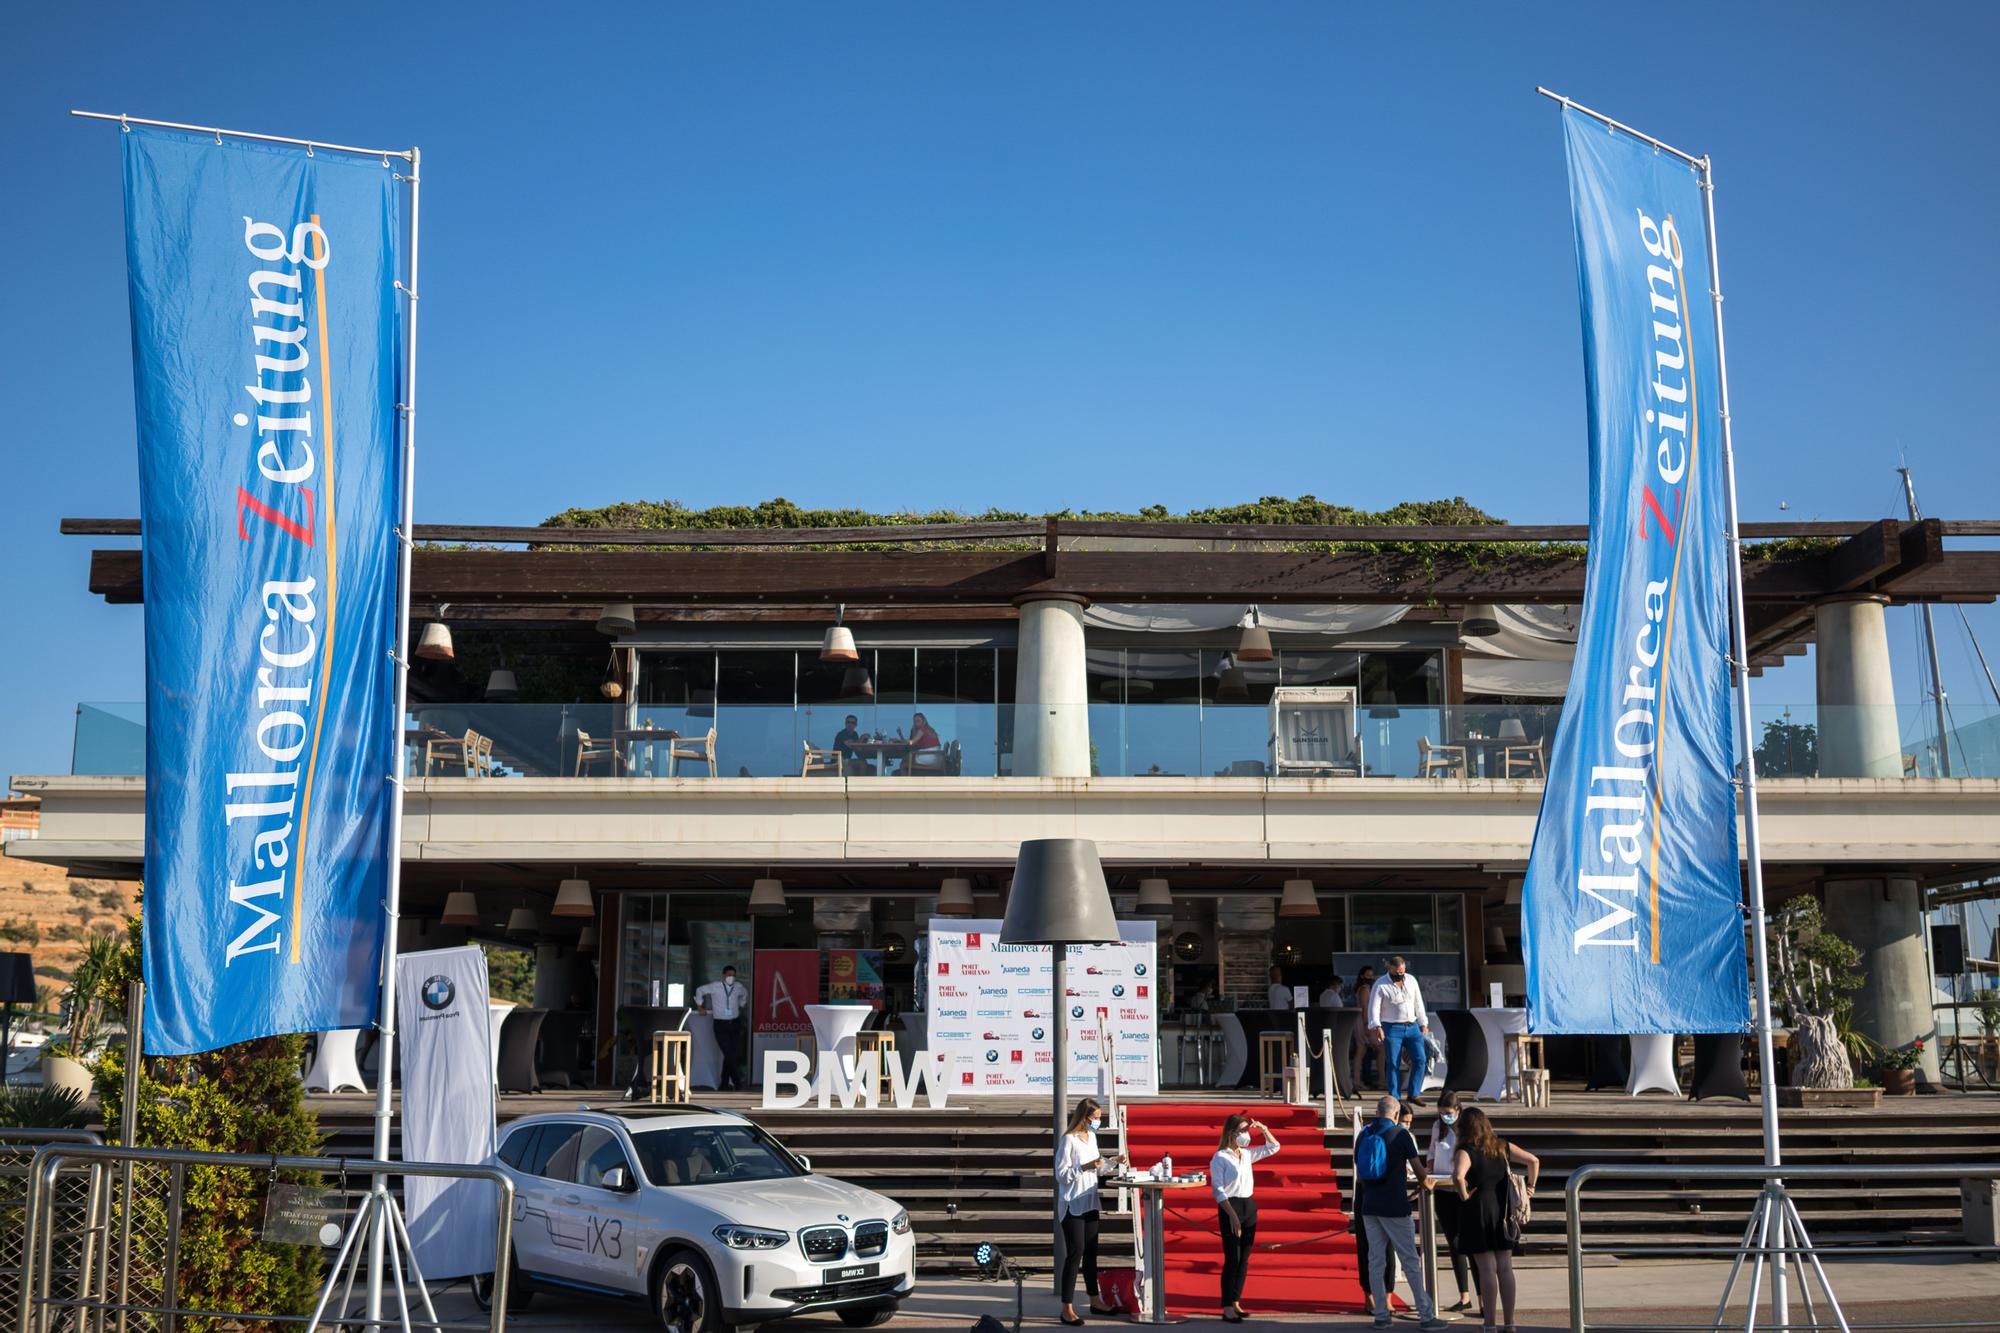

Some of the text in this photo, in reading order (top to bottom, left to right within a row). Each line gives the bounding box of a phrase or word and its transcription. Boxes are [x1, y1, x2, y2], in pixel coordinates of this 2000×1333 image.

[1573, 206, 1685, 955] Mallorca Zeitung
[226, 215, 331, 966] Mallorca Zeitung
[991, 942, 1038, 953] Mallorca
[1001, 965, 1030, 974] juaneda
[979, 986, 1008, 995] juaneda
[938, 1008, 967, 1017] juaneda
[758, 1023, 813, 1031] ABOGADOS
[1120, 1030, 1149, 1040] juaneda
[762, 1050, 955, 1109] BMW
[587, 1216, 623, 1259] iX3
[841, 1267, 864, 1278] BMW X3
